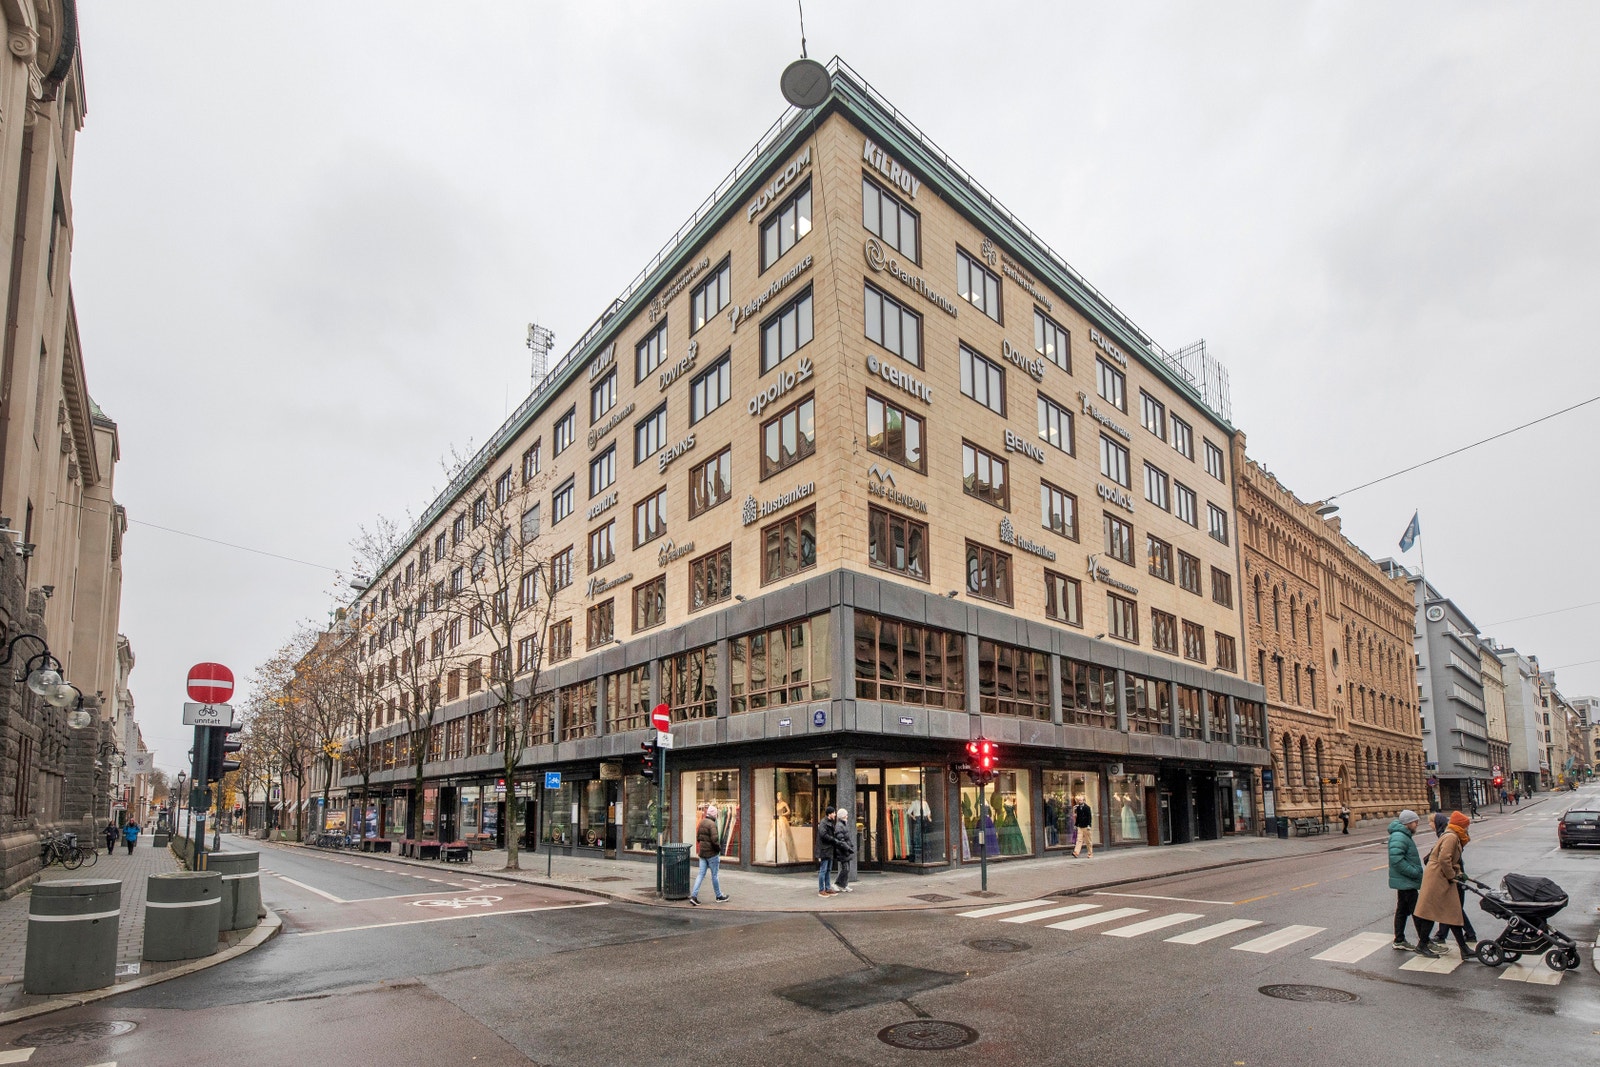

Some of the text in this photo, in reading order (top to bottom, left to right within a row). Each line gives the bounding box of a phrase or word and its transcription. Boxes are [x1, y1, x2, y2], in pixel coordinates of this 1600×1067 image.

[748, 146, 811, 223] FUNCOM
[741, 253, 813, 319] Teleperformance
[889, 257, 958, 319] Grant Thornton
[1002, 339, 1037, 376] Dovre
[1089, 328, 1128, 369] FUNCOM
[659, 357, 688, 393] Dovre
[747, 371, 796, 416] apollo
[880, 362, 933, 404] centric
[659, 433, 696, 474] BENNS
[1004, 428, 1045, 464] BENNS
[760, 480, 815, 518] Husbanken
[1097, 482, 1127, 511] apollo
[1016, 533, 1056, 562] Husbanken
